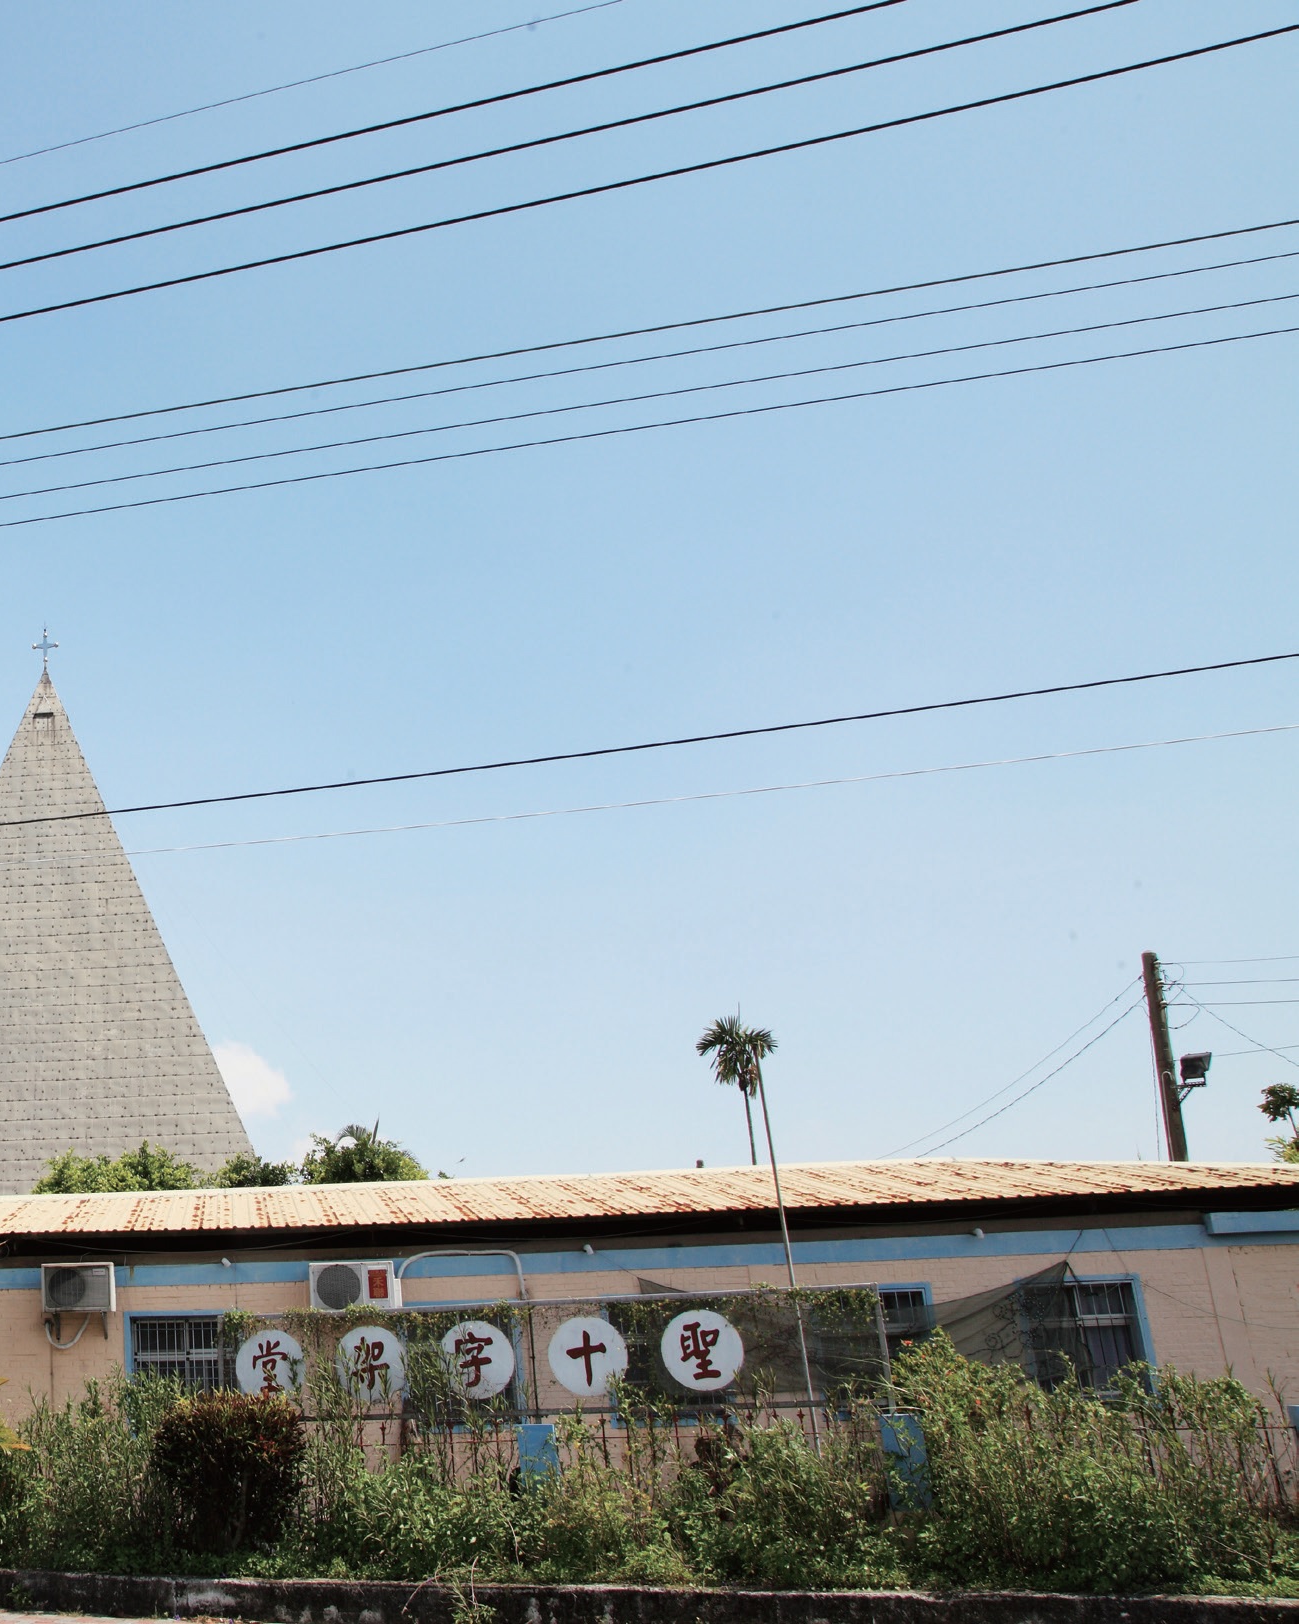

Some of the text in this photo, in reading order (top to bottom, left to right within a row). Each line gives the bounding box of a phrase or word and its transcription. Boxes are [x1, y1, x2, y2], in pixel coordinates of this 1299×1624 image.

[252, 1321, 722, 1394] 聖十字架堂
